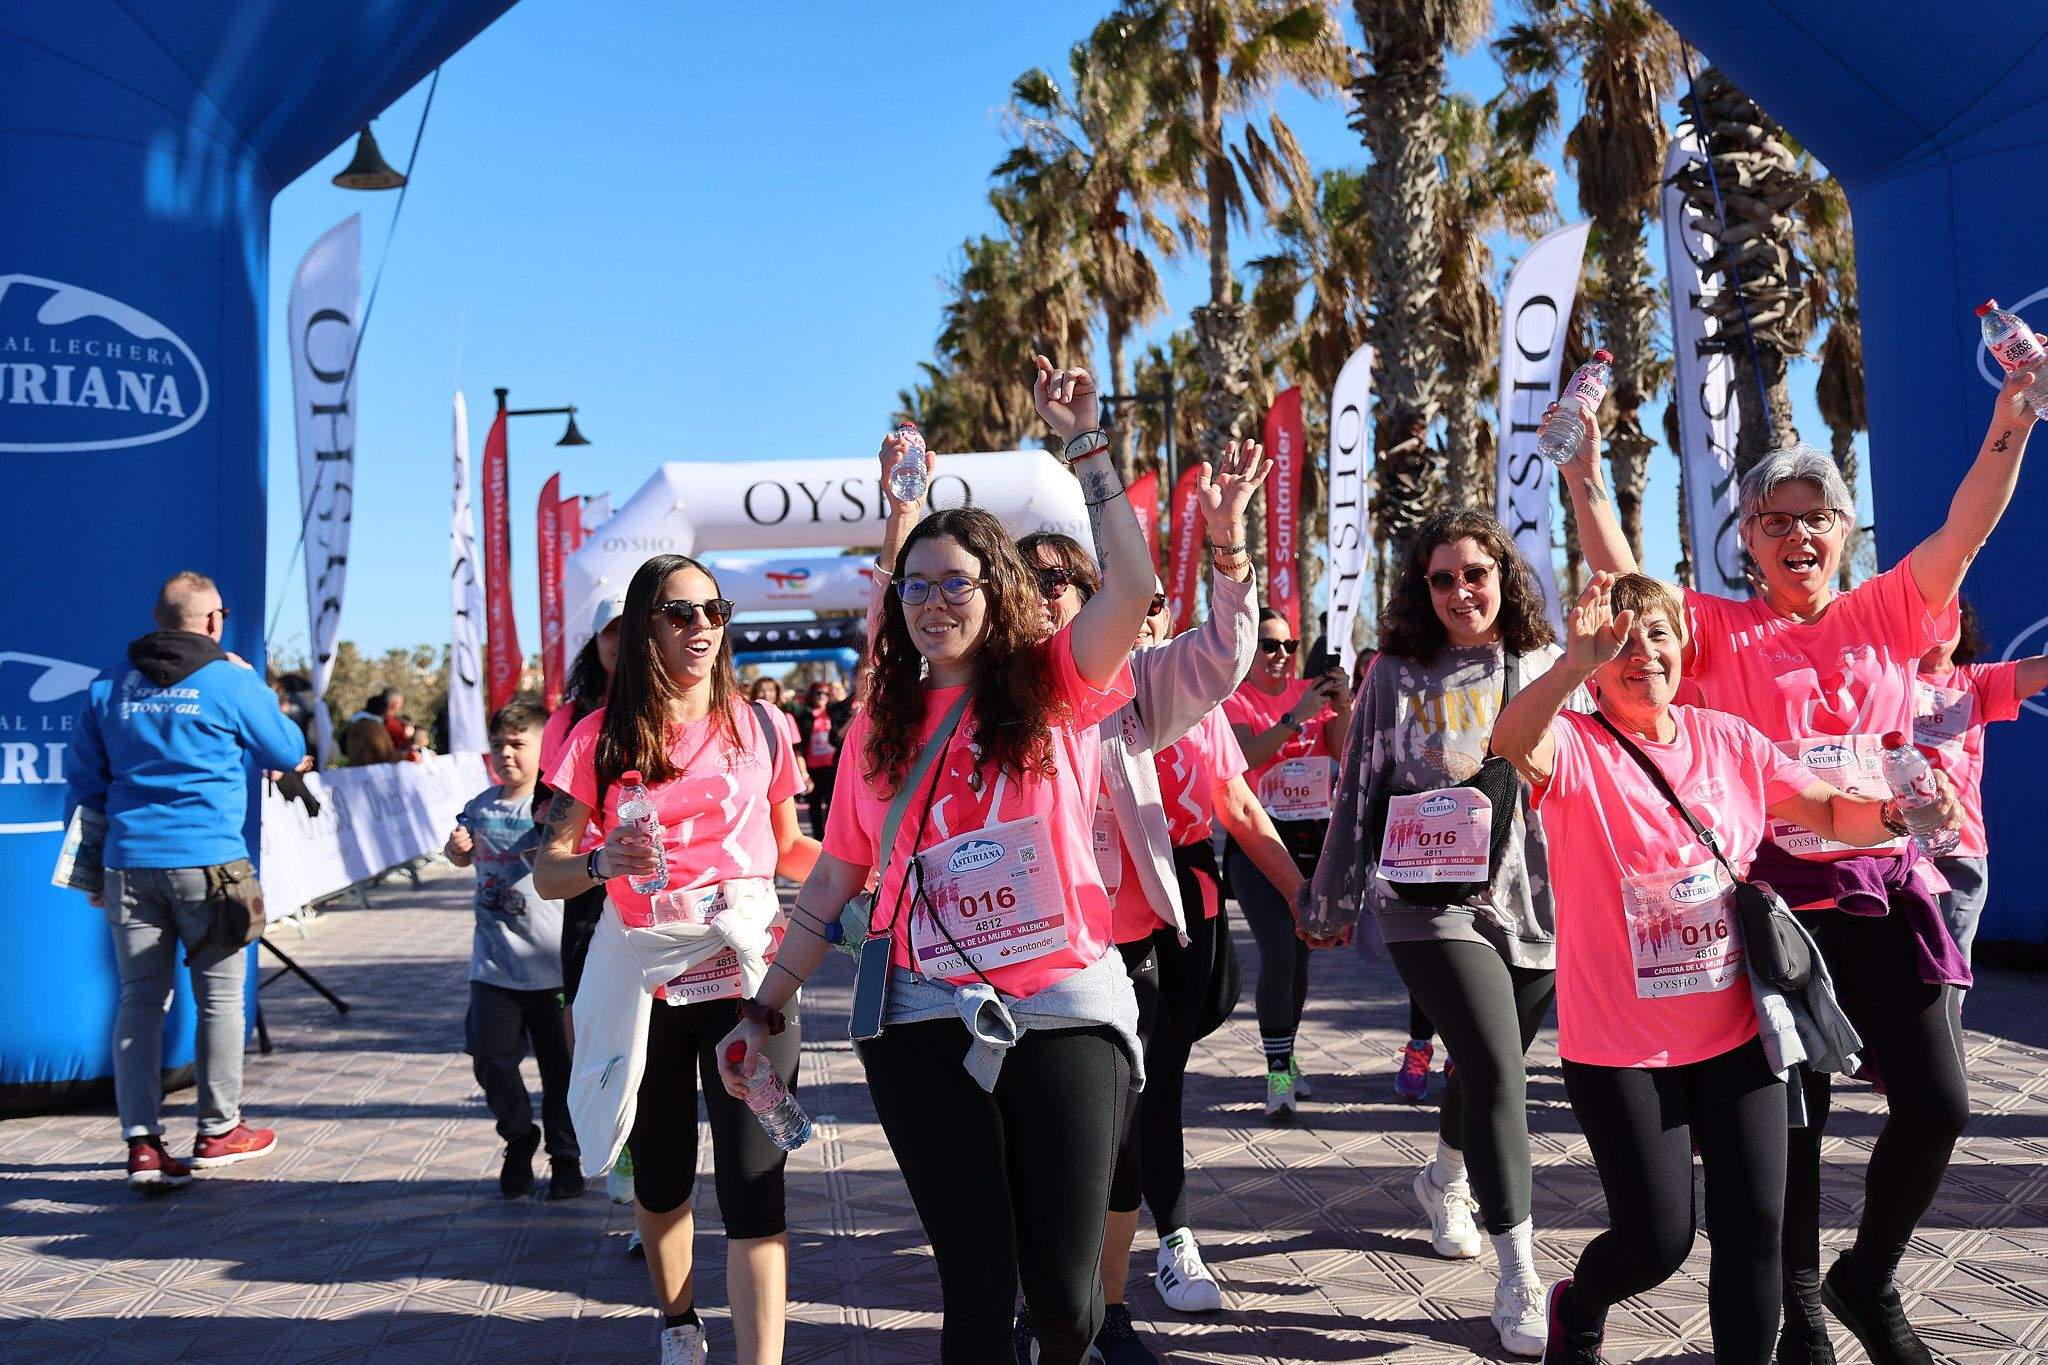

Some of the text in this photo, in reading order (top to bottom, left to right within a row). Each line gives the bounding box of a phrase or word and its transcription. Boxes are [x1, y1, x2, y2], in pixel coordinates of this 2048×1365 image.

[50, 337, 174, 366] LECHERA
[2004, 339, 2029, 357] ZERO
[2007, 344, 2032, 362] SODIO
[1578, 382, 1600, 395] ZERO
[1508, 294, 1560, 538] YSHO
[1275, 428, 1290, 562] Santander
[602, 537, 674, 552] OYSHO
[133, 687, 200, 699] SPEAKER
[175, 703, 201, 716] GIL
[1284, 786, 1309, 797] 016
[1422, 803, 1455, 814] ASTURIANA
[1418, 830, 1457, 847] 016
[952, 849, 1001, 870] ASTURIANA
[959, 886, 1016, 918] 016
[976, 918, 1003, 931] 4812
[988, 930, 1012, 941] MUJER
[1016, 921, 1050, 934] VALENCIA
[1681, 918, 1729, 946] 016
[1012, 937, 1054, 954] Santander
[1695, 947, 1718, 959] 4810
[716, 955, 737, 967] 4813
[1654, 965, 1684, 975] CARRERA
[680, 973, 706, 983] CARRERA
[1653, 977, 1698, 990] OYSHO
[680, 983, 720, 997] OYSHO
